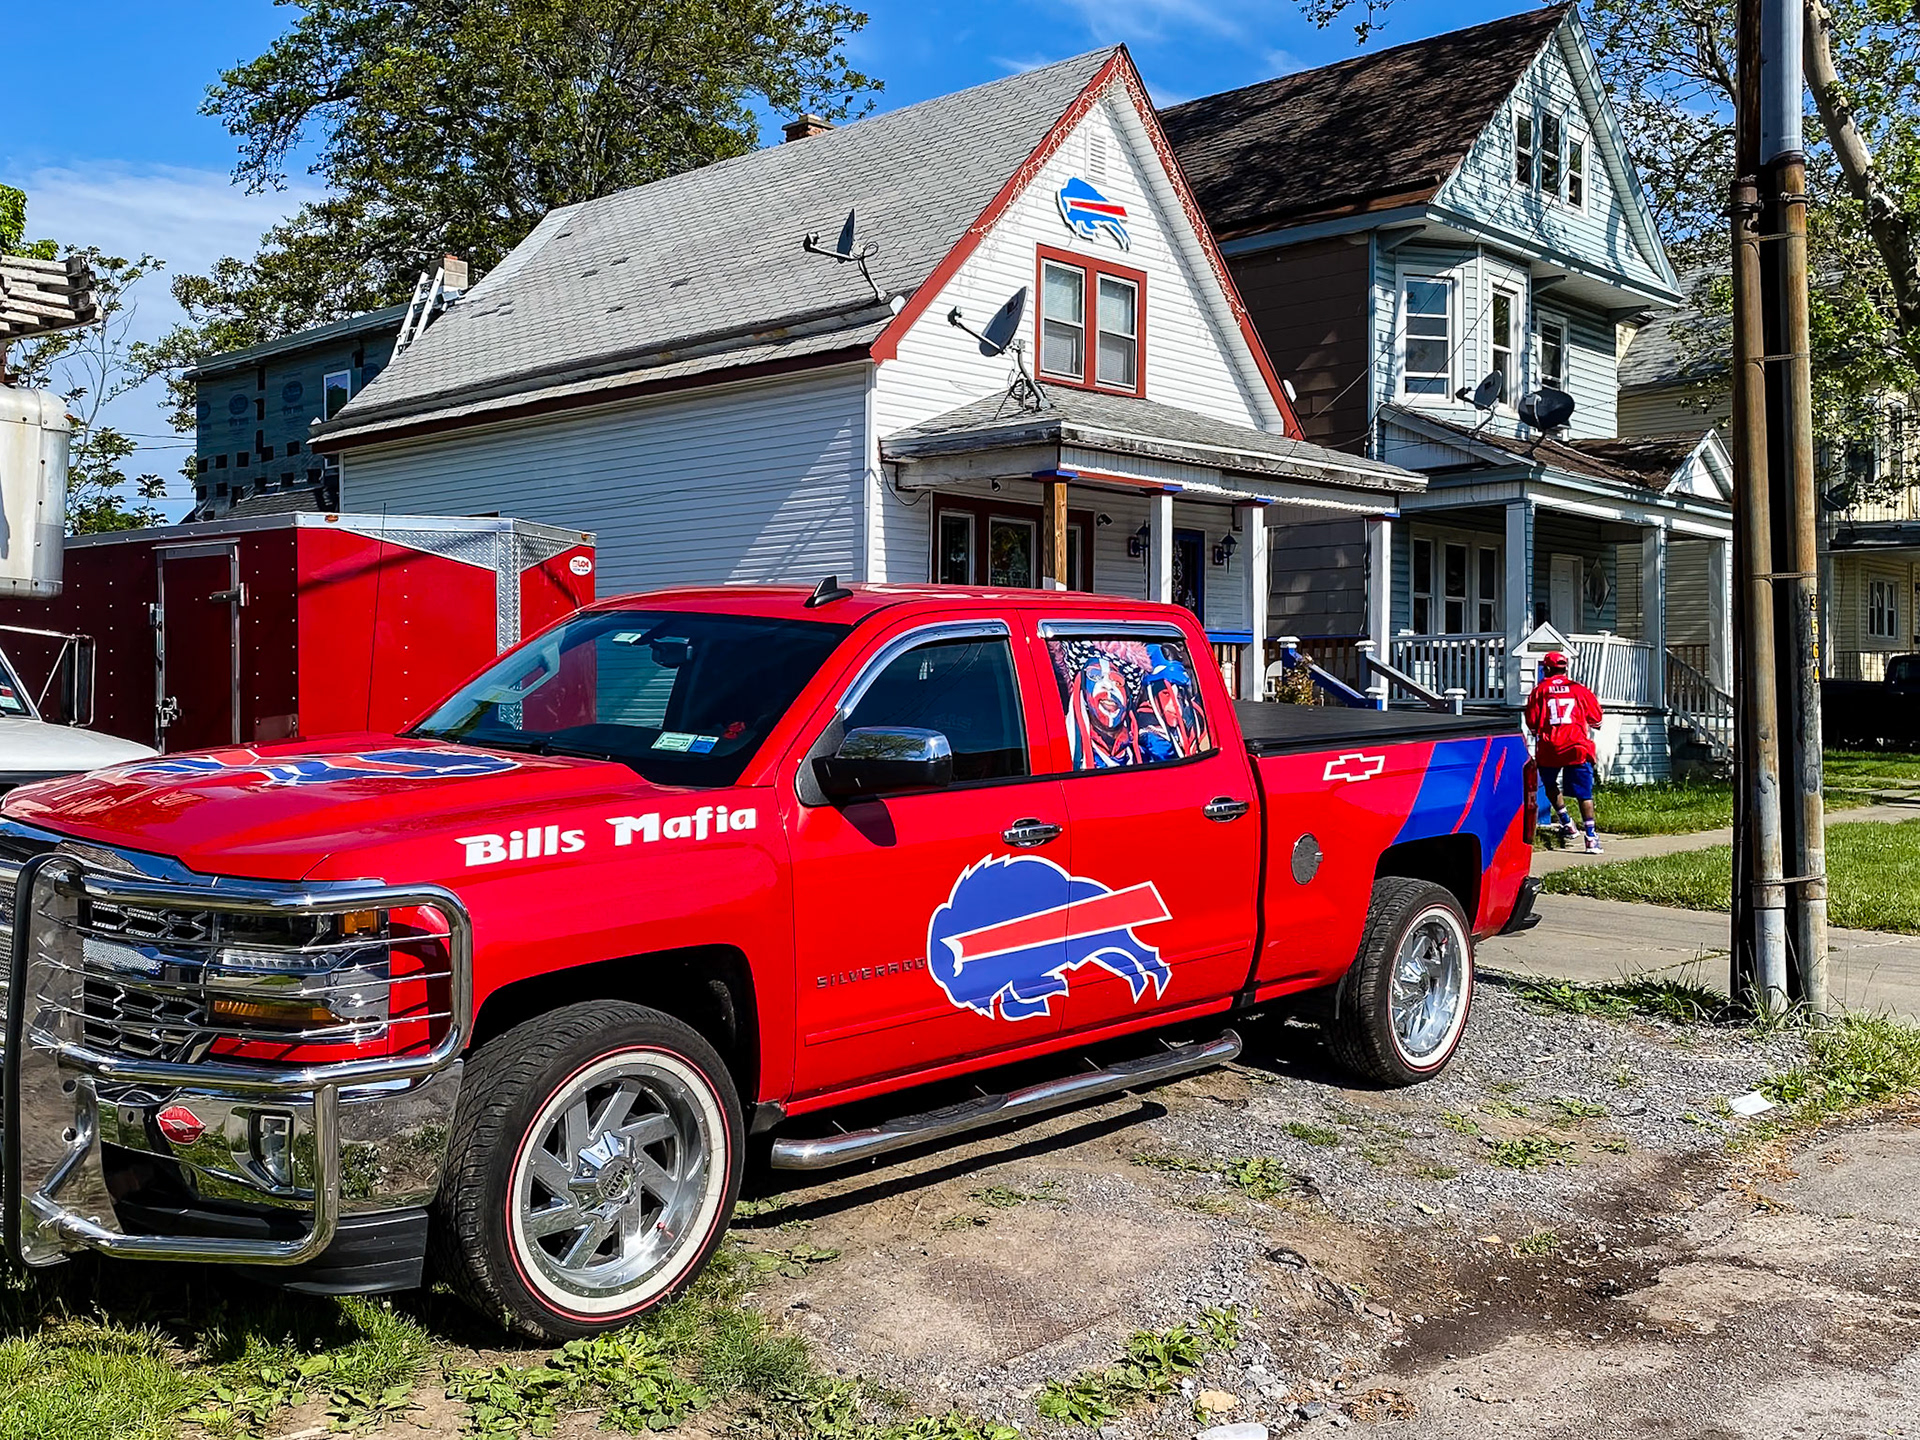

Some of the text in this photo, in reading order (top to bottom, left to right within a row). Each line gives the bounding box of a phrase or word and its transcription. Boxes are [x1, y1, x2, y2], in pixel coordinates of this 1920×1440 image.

[1547, 697, 1576, 725] 17
[454, 805, 756, 867] Bills Mafia
[816, 957, 926, 989] SILVERADO
